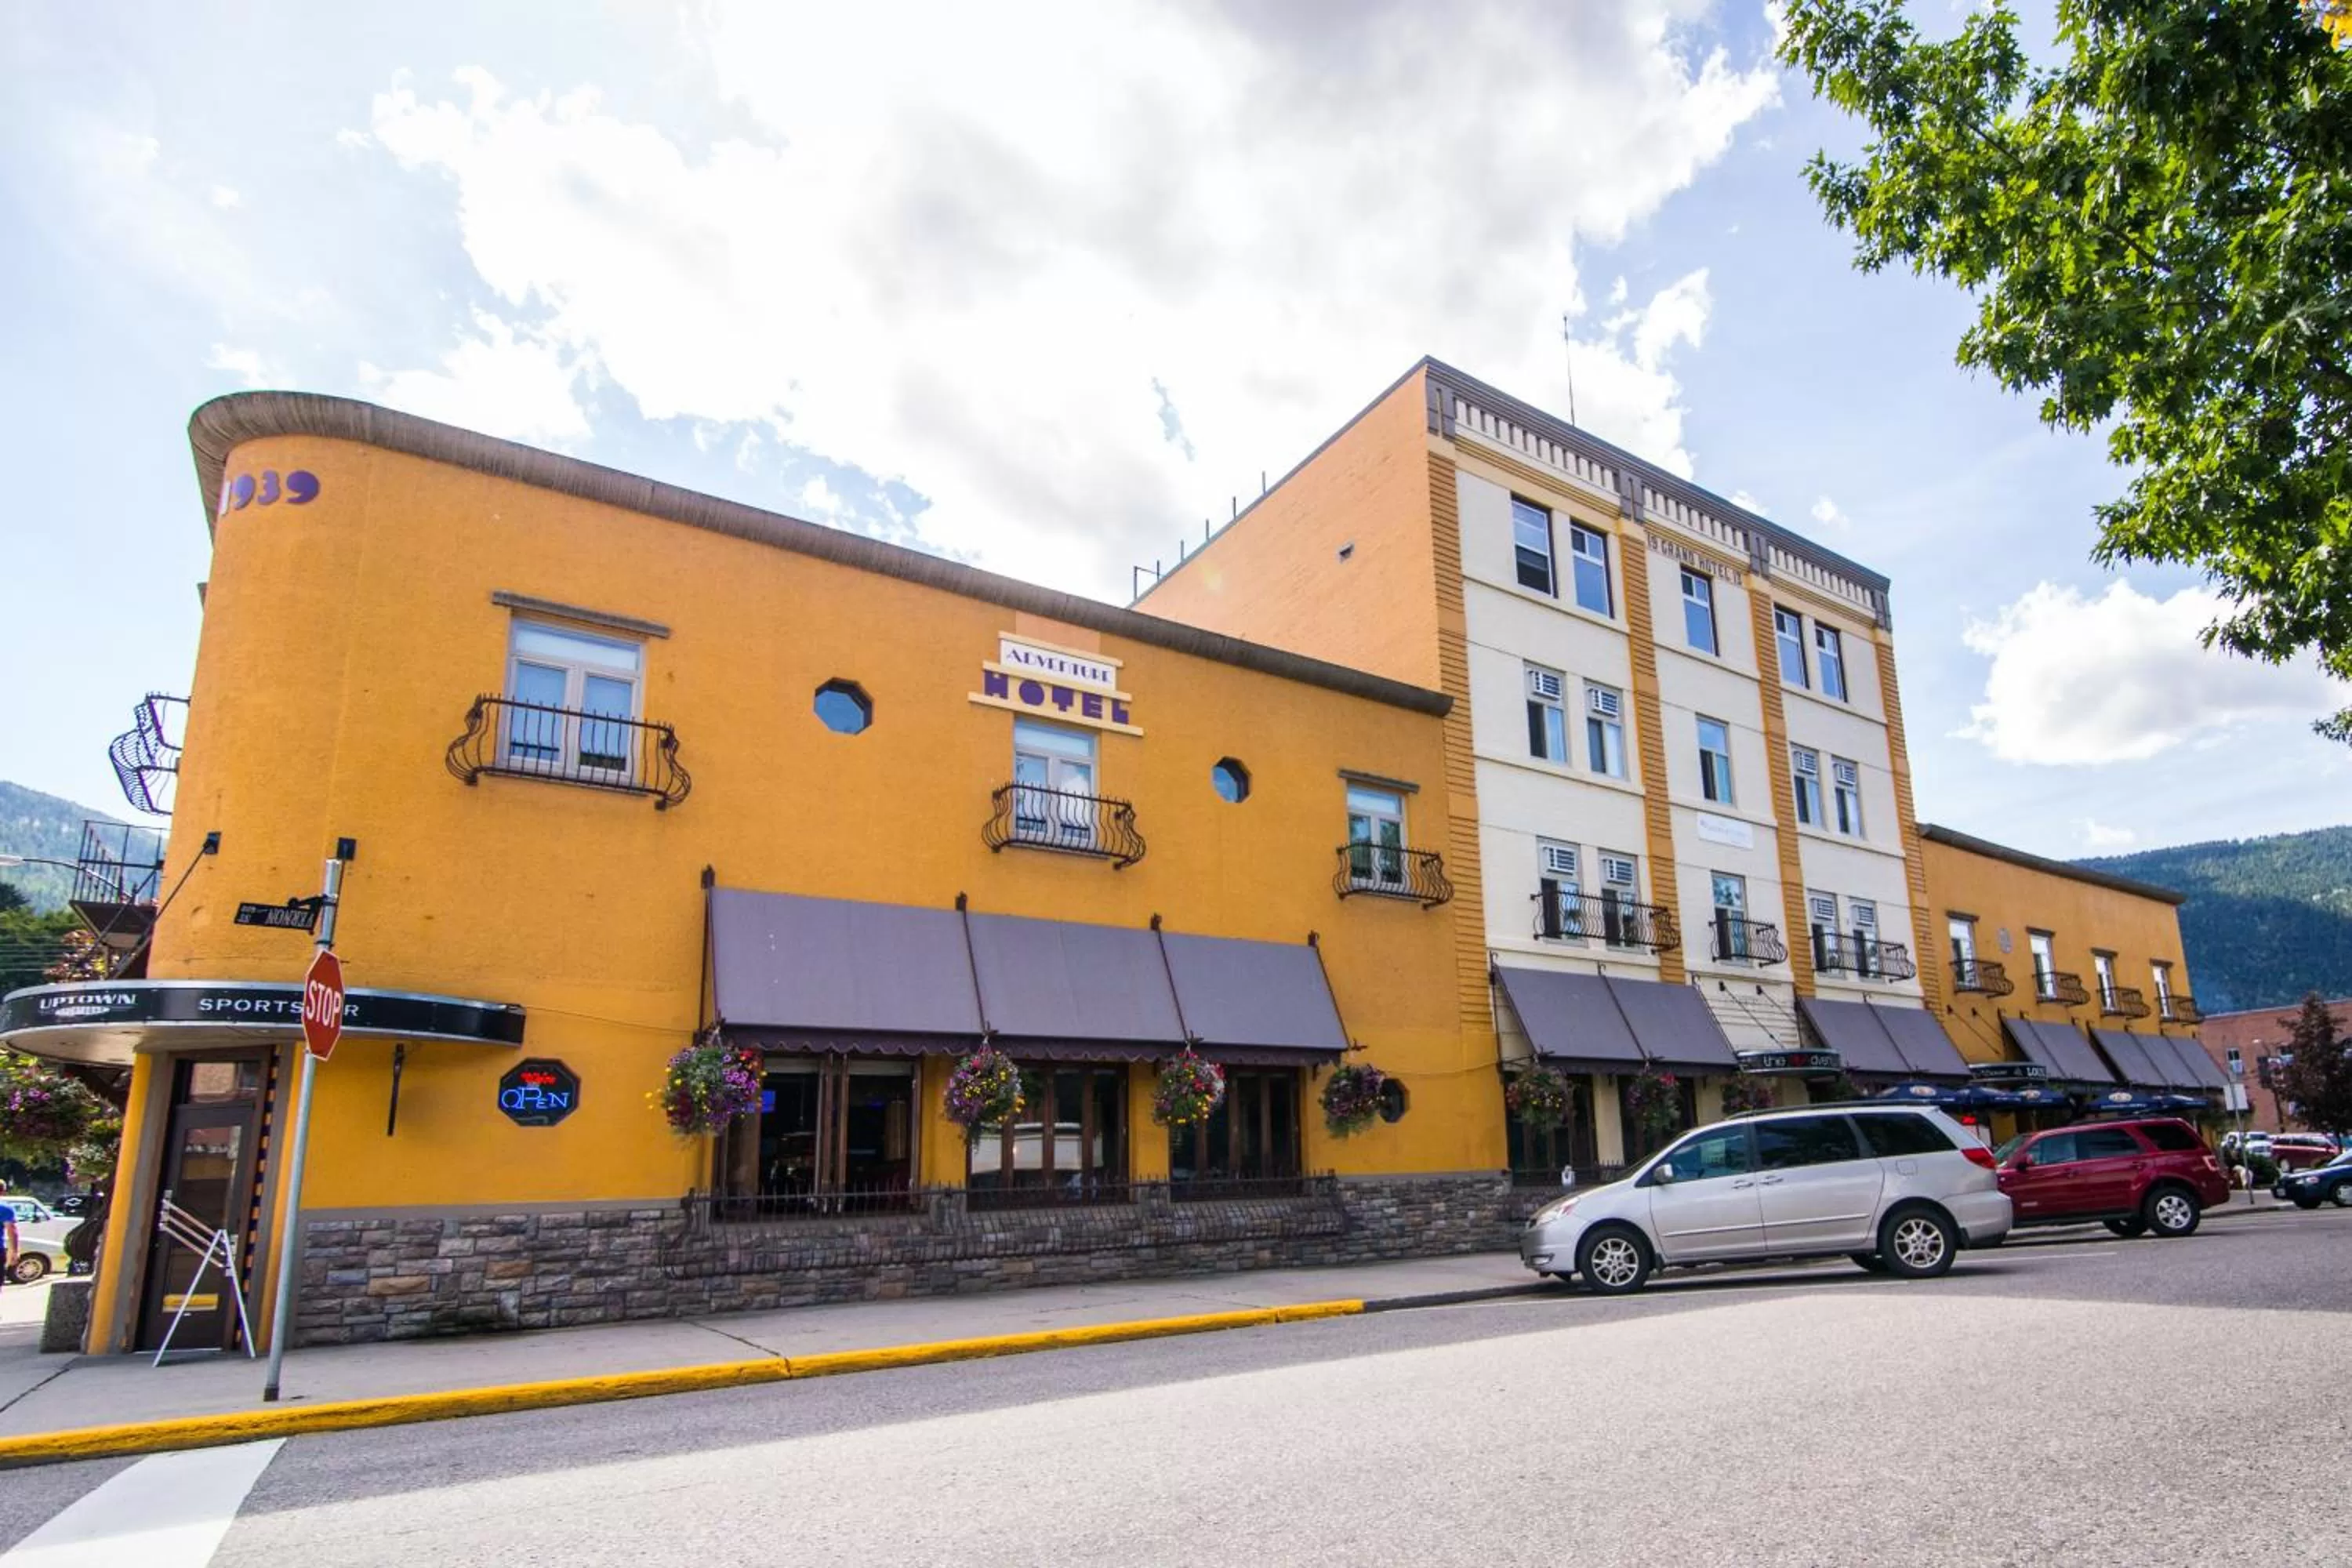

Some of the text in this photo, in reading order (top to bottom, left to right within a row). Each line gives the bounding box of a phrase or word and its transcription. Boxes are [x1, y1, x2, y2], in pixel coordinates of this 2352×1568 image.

[1661, 539, 1694, 564] GRAND
[1699, 558, 1730, 581] HOTEL
[1007, 649, 1112, 683] ADVENTURE
[984, 670, 1129, 724] HOTEL
[265, 909, 314, 927] VERNON
[40, 993, 138, 1010] UPTOWN
[307, 980, 341, 1029] STOP
[502, 1087, 570, 1109] OPEN
